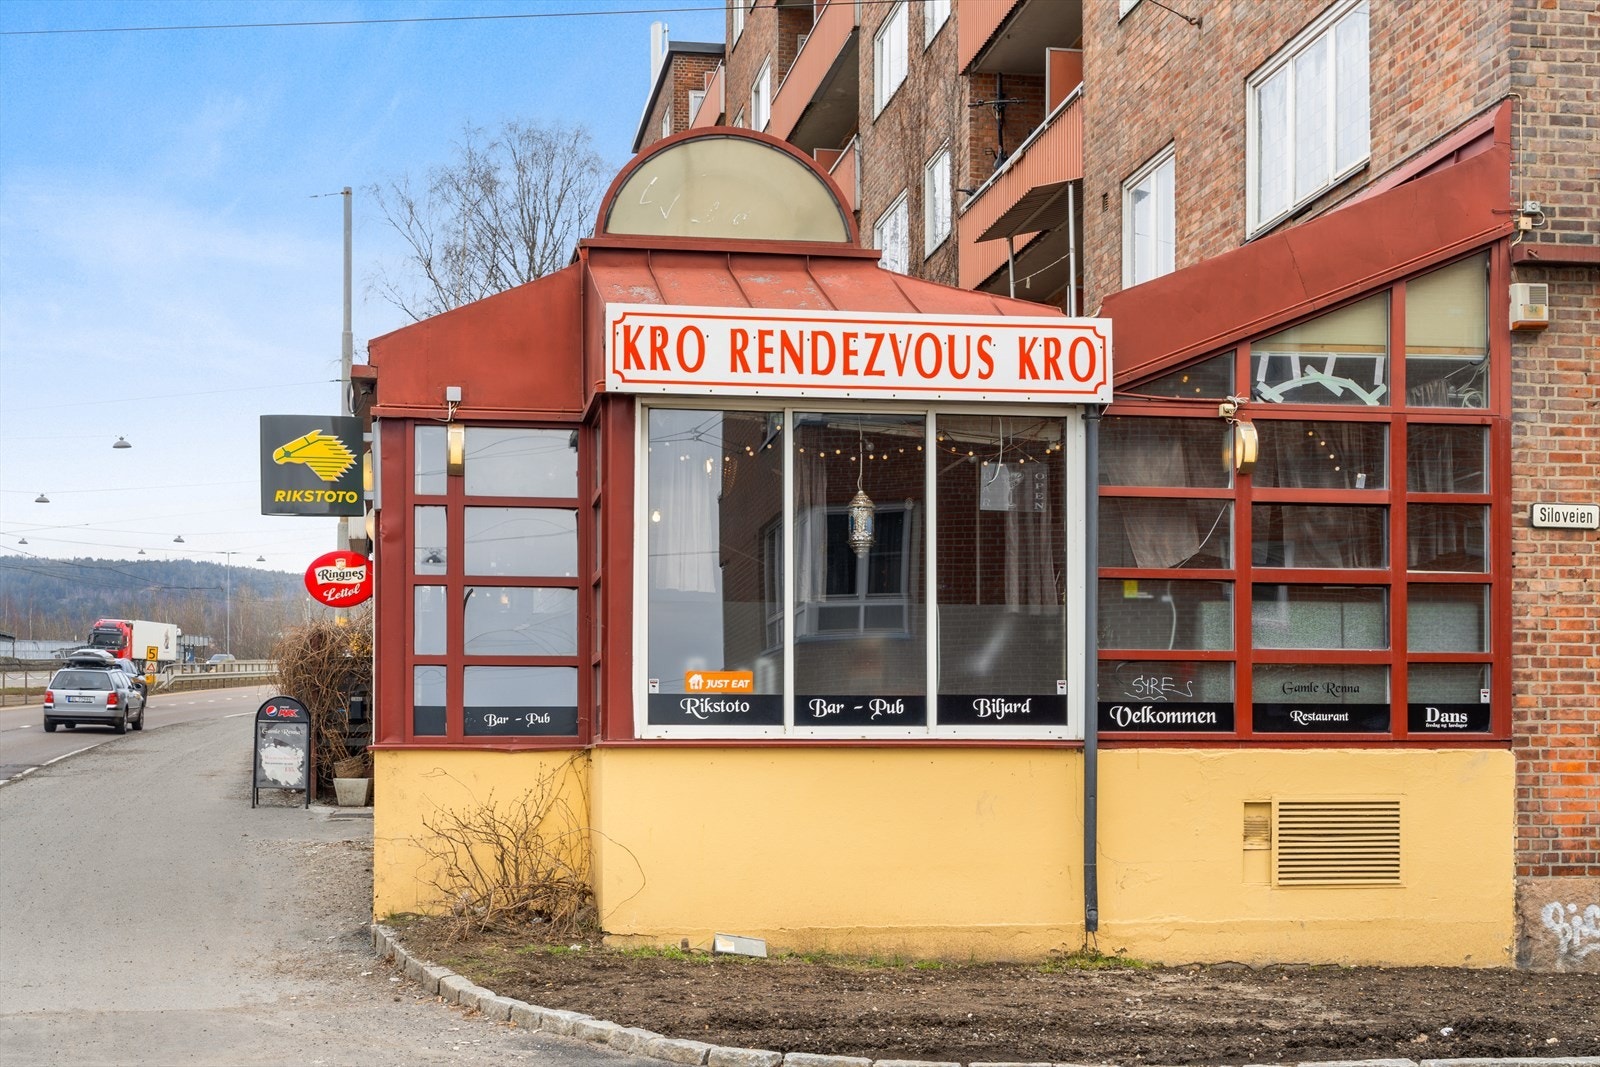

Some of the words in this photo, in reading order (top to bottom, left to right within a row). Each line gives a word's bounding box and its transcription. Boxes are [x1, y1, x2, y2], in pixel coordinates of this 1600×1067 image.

[623, 324, 706, 374] KRO
[730, 327, 995, 381] RENDEZVOUS
[1018, 335, 1097, 383] KRO
[274, 489, 359, 504] RIKSTOTO
[1034, 472, 1046, 510] OPEN
[1540, 507, 1593, 524] Siloveien
[318, 569, 365, 582] Ringnes
[148, 648, 156, 660] 5
[705, 679, 730, 689] JUST
[731, 679, 751, 689] EAT
[1282, 681, 1320, 696] Gamle
[1322, 681, 1360, 698] Renna
[680, 697, 750, 720] Rikstoto
[808, 698, 845, 718] Bar
[869, 698, 905, 720] Pub
[972, 698, 1032, 720] Biljard
[1109, 705, 1217, 728] Velkommen
[1425, 707, 1468, 723] Dans
[483, 713, 509, 727] Bar
[525, 712, 551, 728] Pub
[1290, 710, 1349, 726] Restaurant
